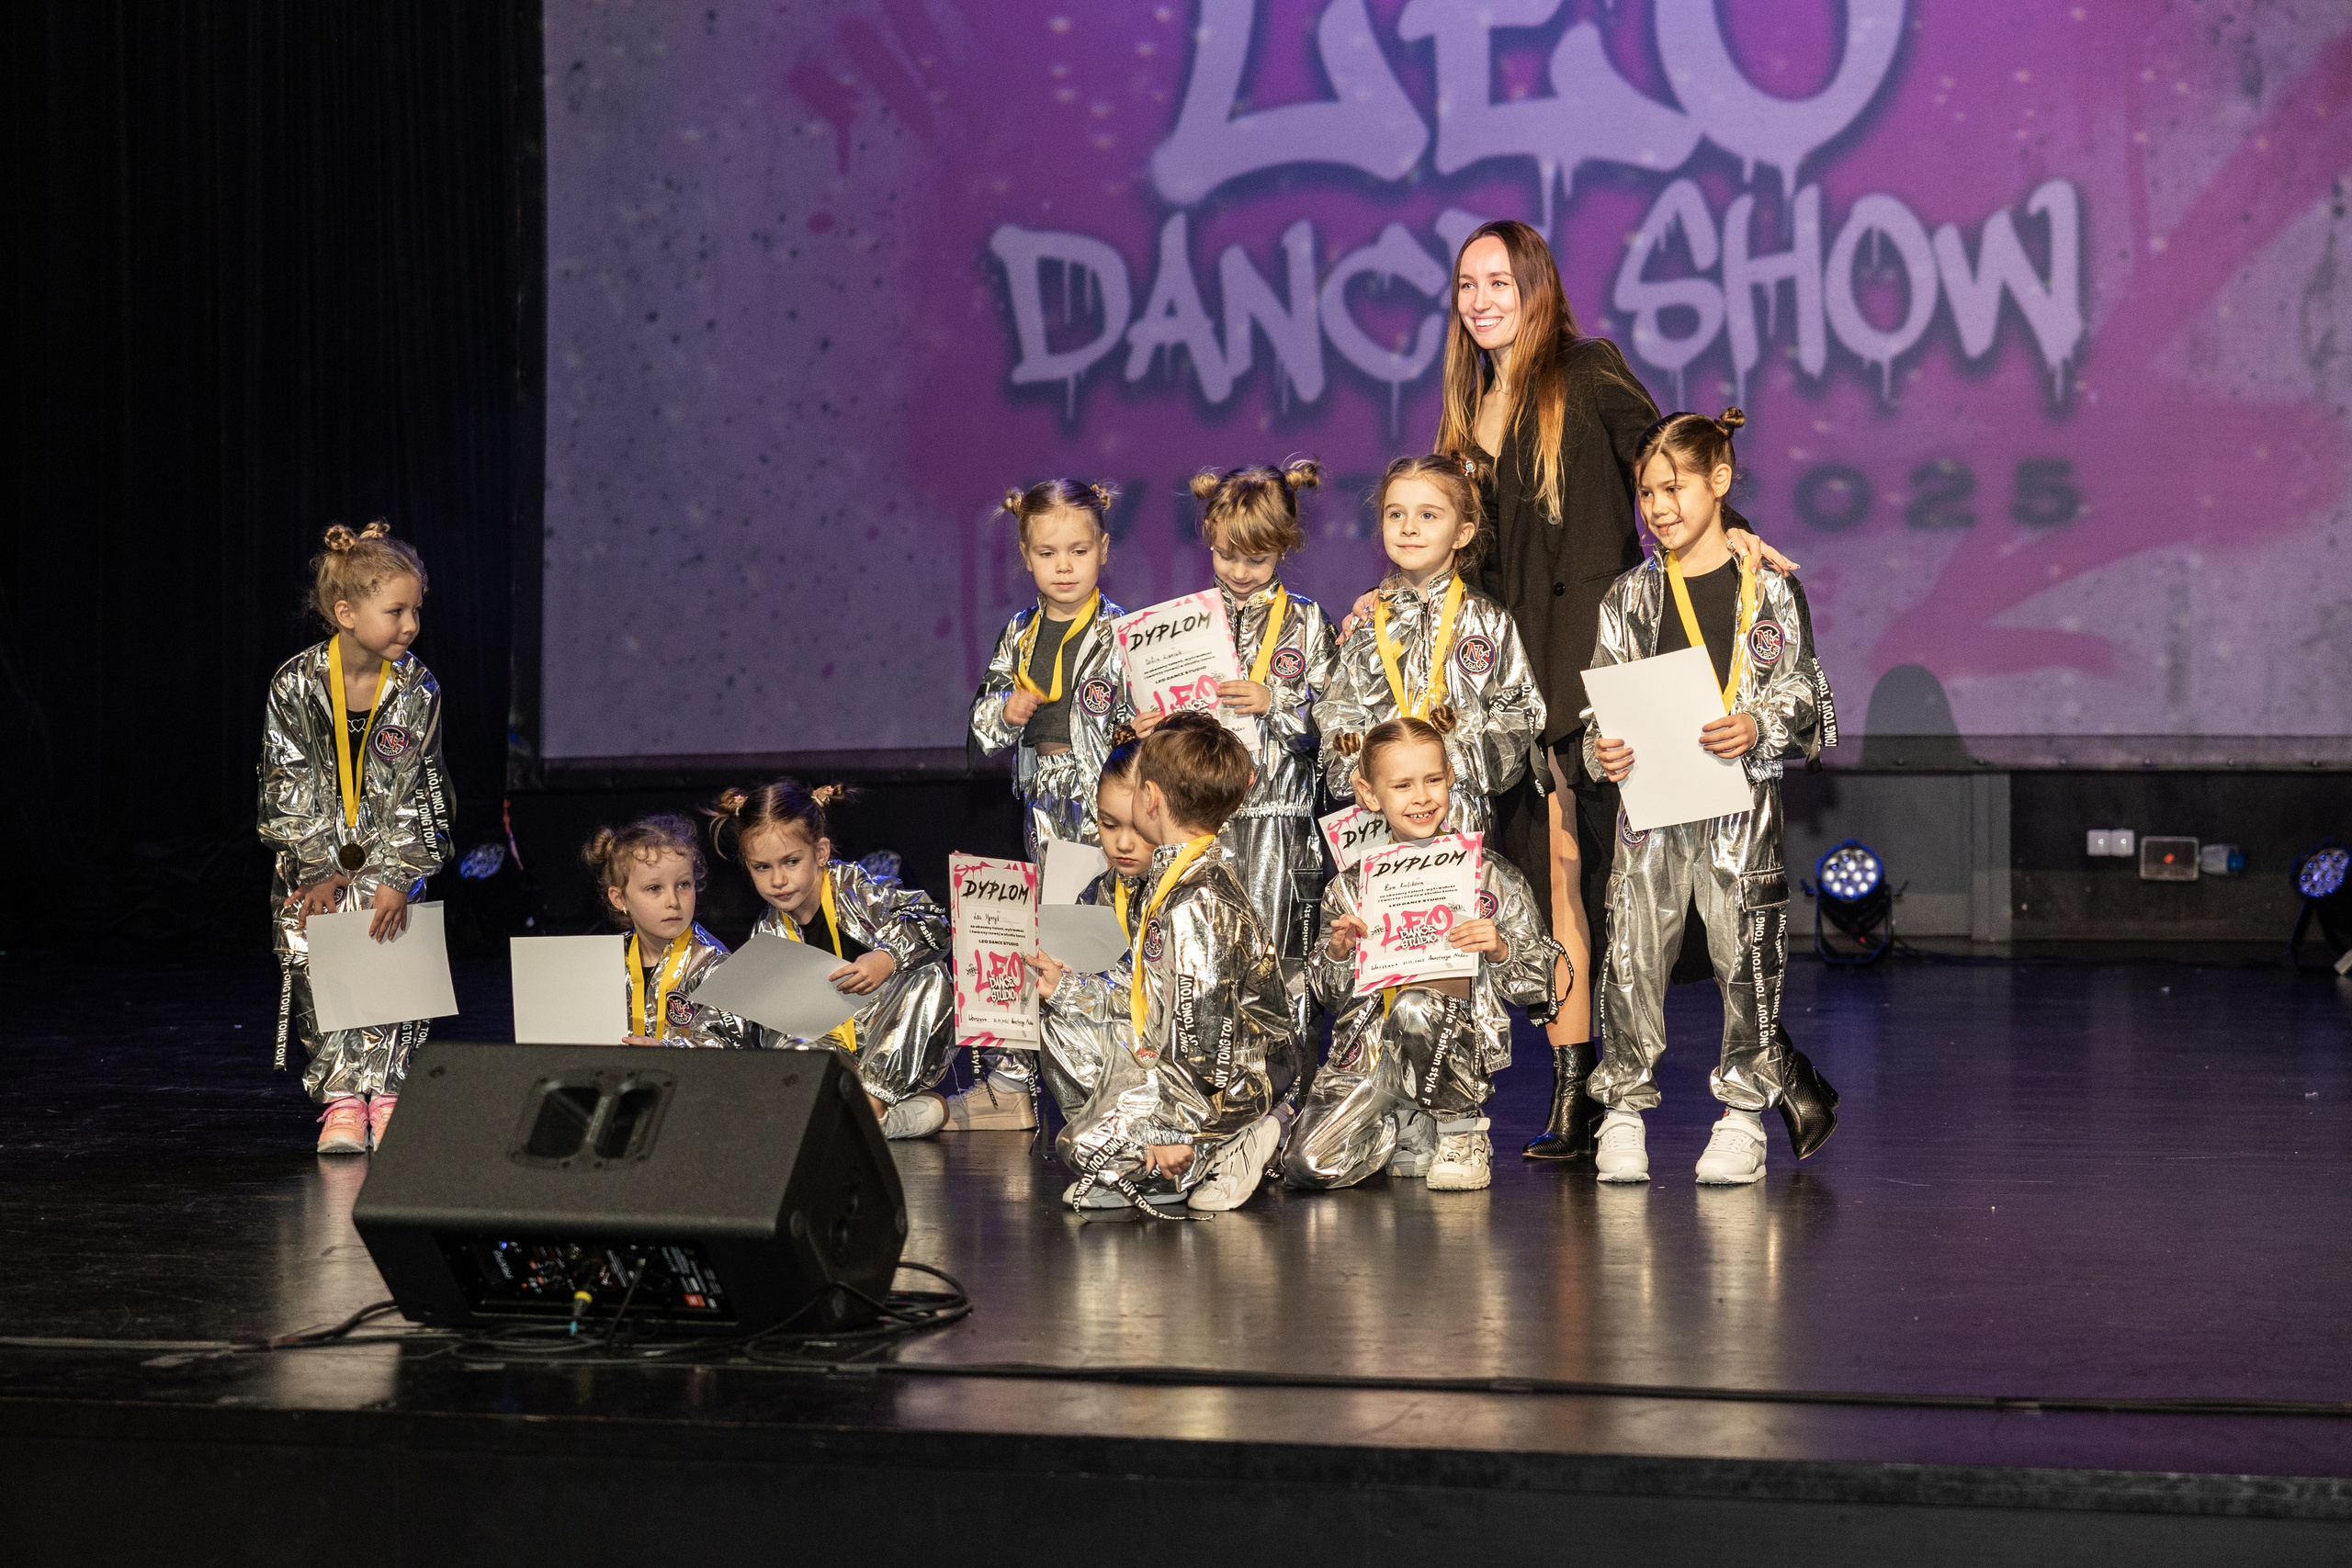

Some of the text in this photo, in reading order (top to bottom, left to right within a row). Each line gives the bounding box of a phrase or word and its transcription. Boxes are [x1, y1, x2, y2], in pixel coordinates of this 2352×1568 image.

[1614, 179, 2087, 372] SHOW
[1742, 458, 2084, 531] 025
[1128, 611, 1212, 652] DYPLOM
[1372, 850, 1468, 878] DYPLOM
[962, 879, 1030, 906] DYPLOM
[1398, 923, 1438, 940] DANCE
[1400, 933, 1437, 950] STUDIO
[989, 976, 1015, 989] DANCE
[990, 988, 1016, 1002] STUDIO
[1435, 1027, 1453, 1066] Fashion
[1424, 1066, 1439, 1093] style
